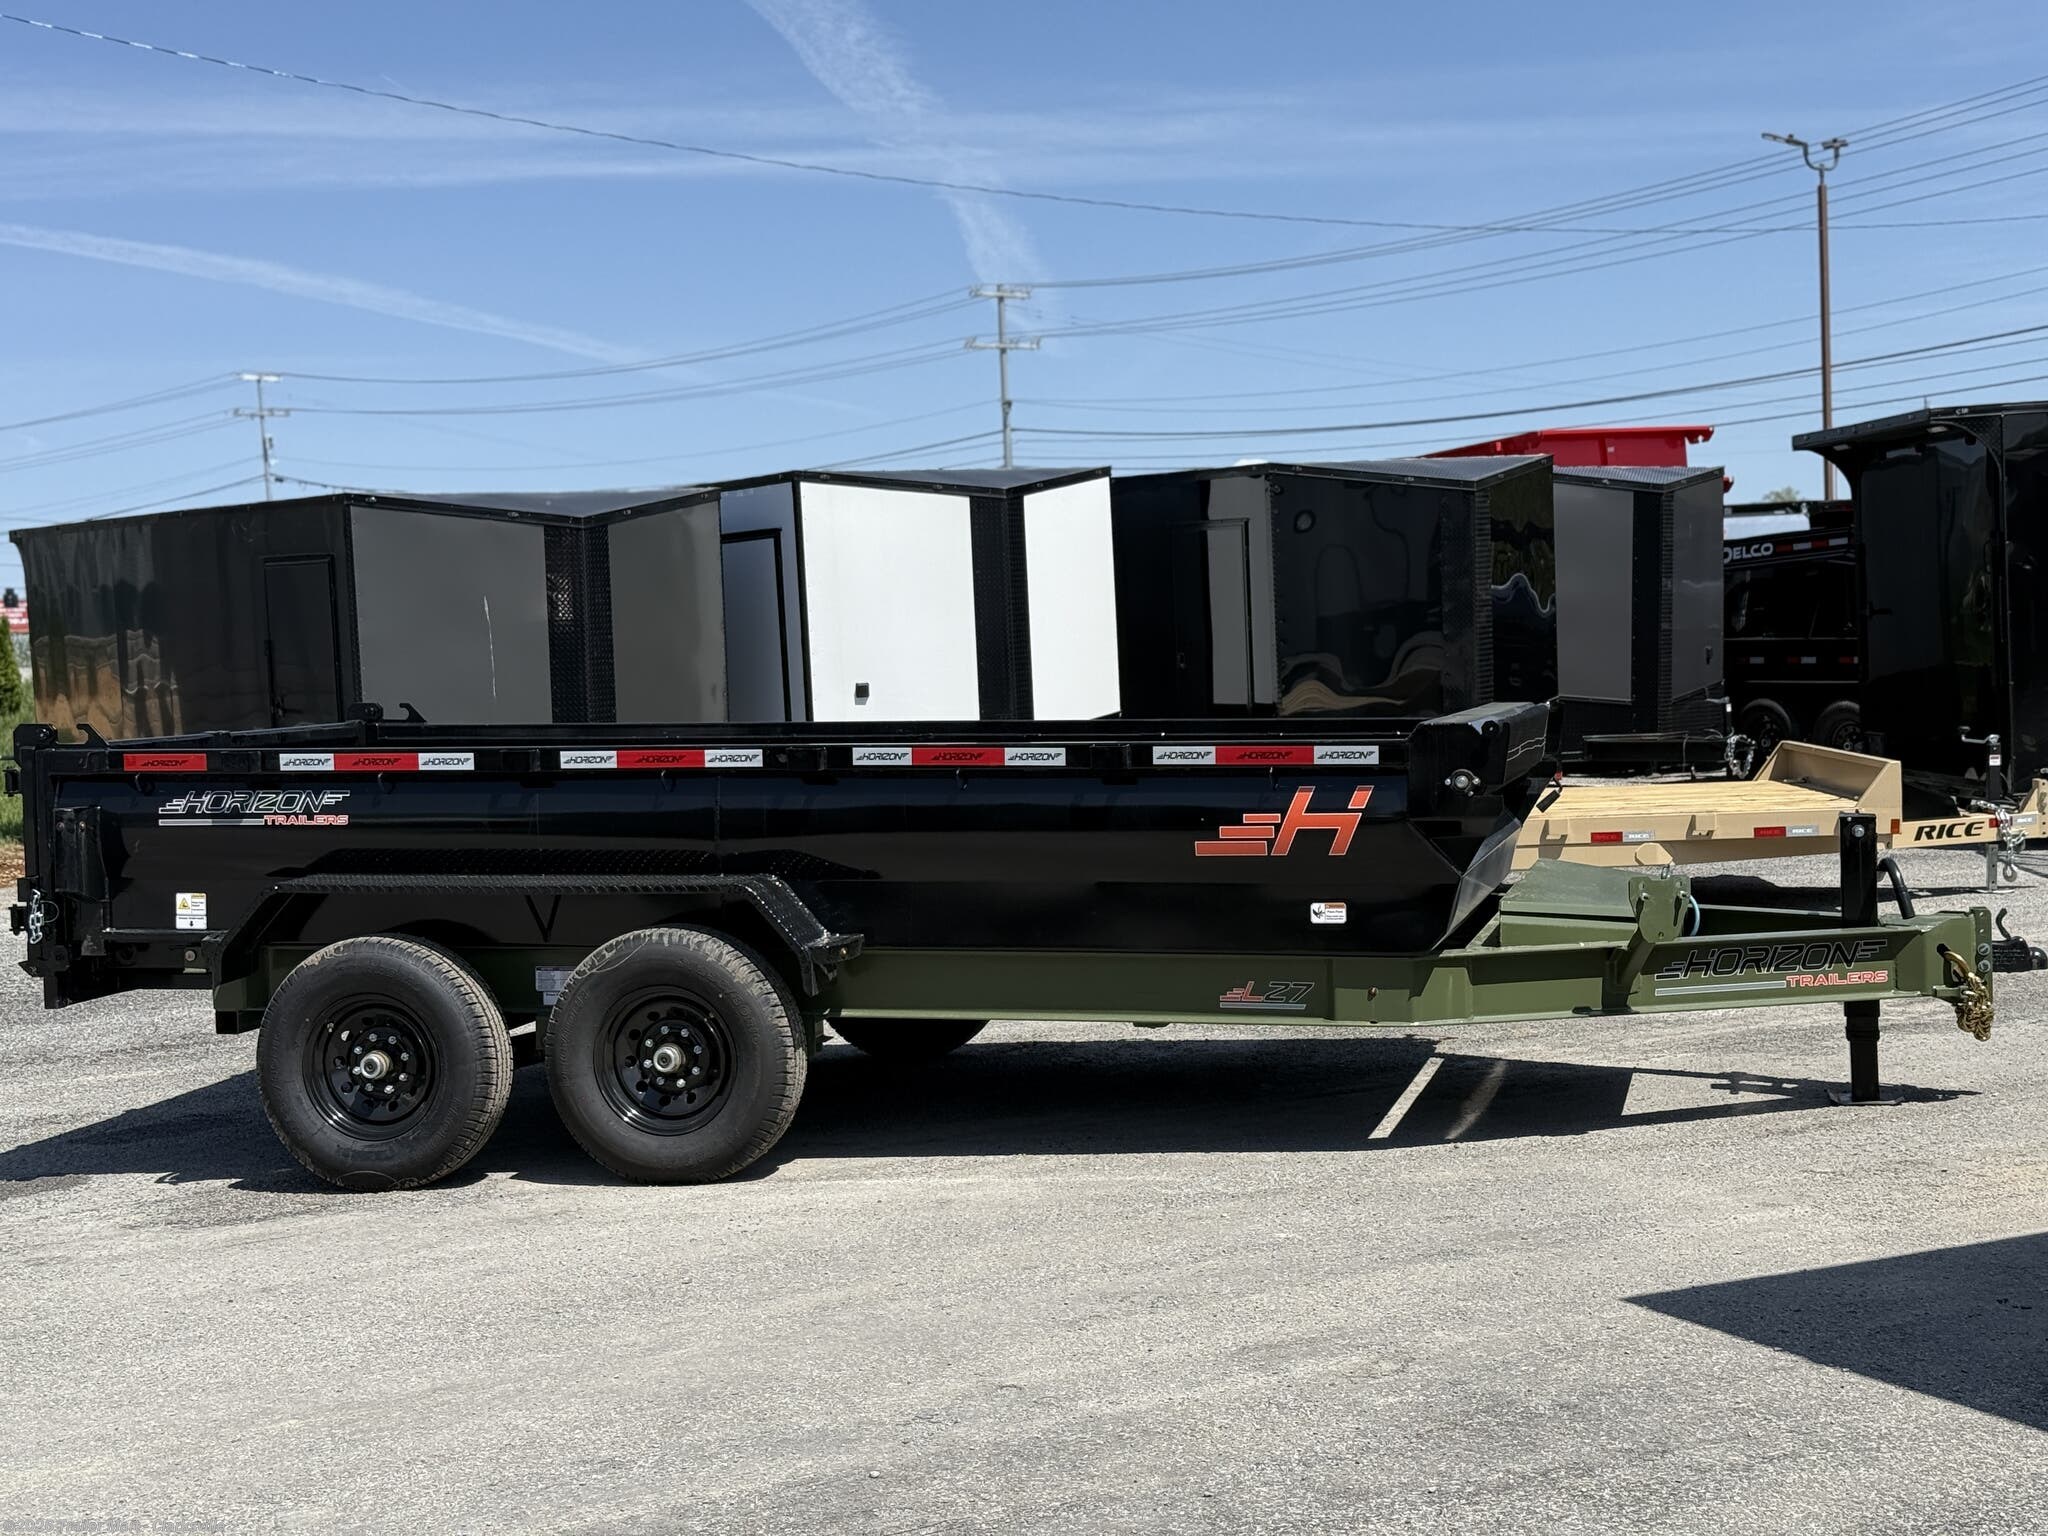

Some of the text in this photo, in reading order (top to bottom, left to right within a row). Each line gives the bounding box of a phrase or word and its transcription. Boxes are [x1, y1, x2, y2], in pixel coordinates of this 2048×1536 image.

[1723, 543, 1773, 564] DELCO
[287, 757, 465, 766] HORIZON HORIZON HORIZON
[569, 754, 754, 764] HORIZON HORIZON HORIZON
[861, 752, 1056, 761] HORIZON HORIZON HORIZON
[1162, 751, 1208, 760] HORIZON
[1323, 751, 1370, 760] HORIZON
[180, 790, 330, 814] HORIZON
[263, 814, 349, 826] TRAILERS
[1913, 821, 1986, 842] RICE
[1681, 940, 1862, 979] HORIZON
[1785, 970, 1889, 988] TRAILERS
